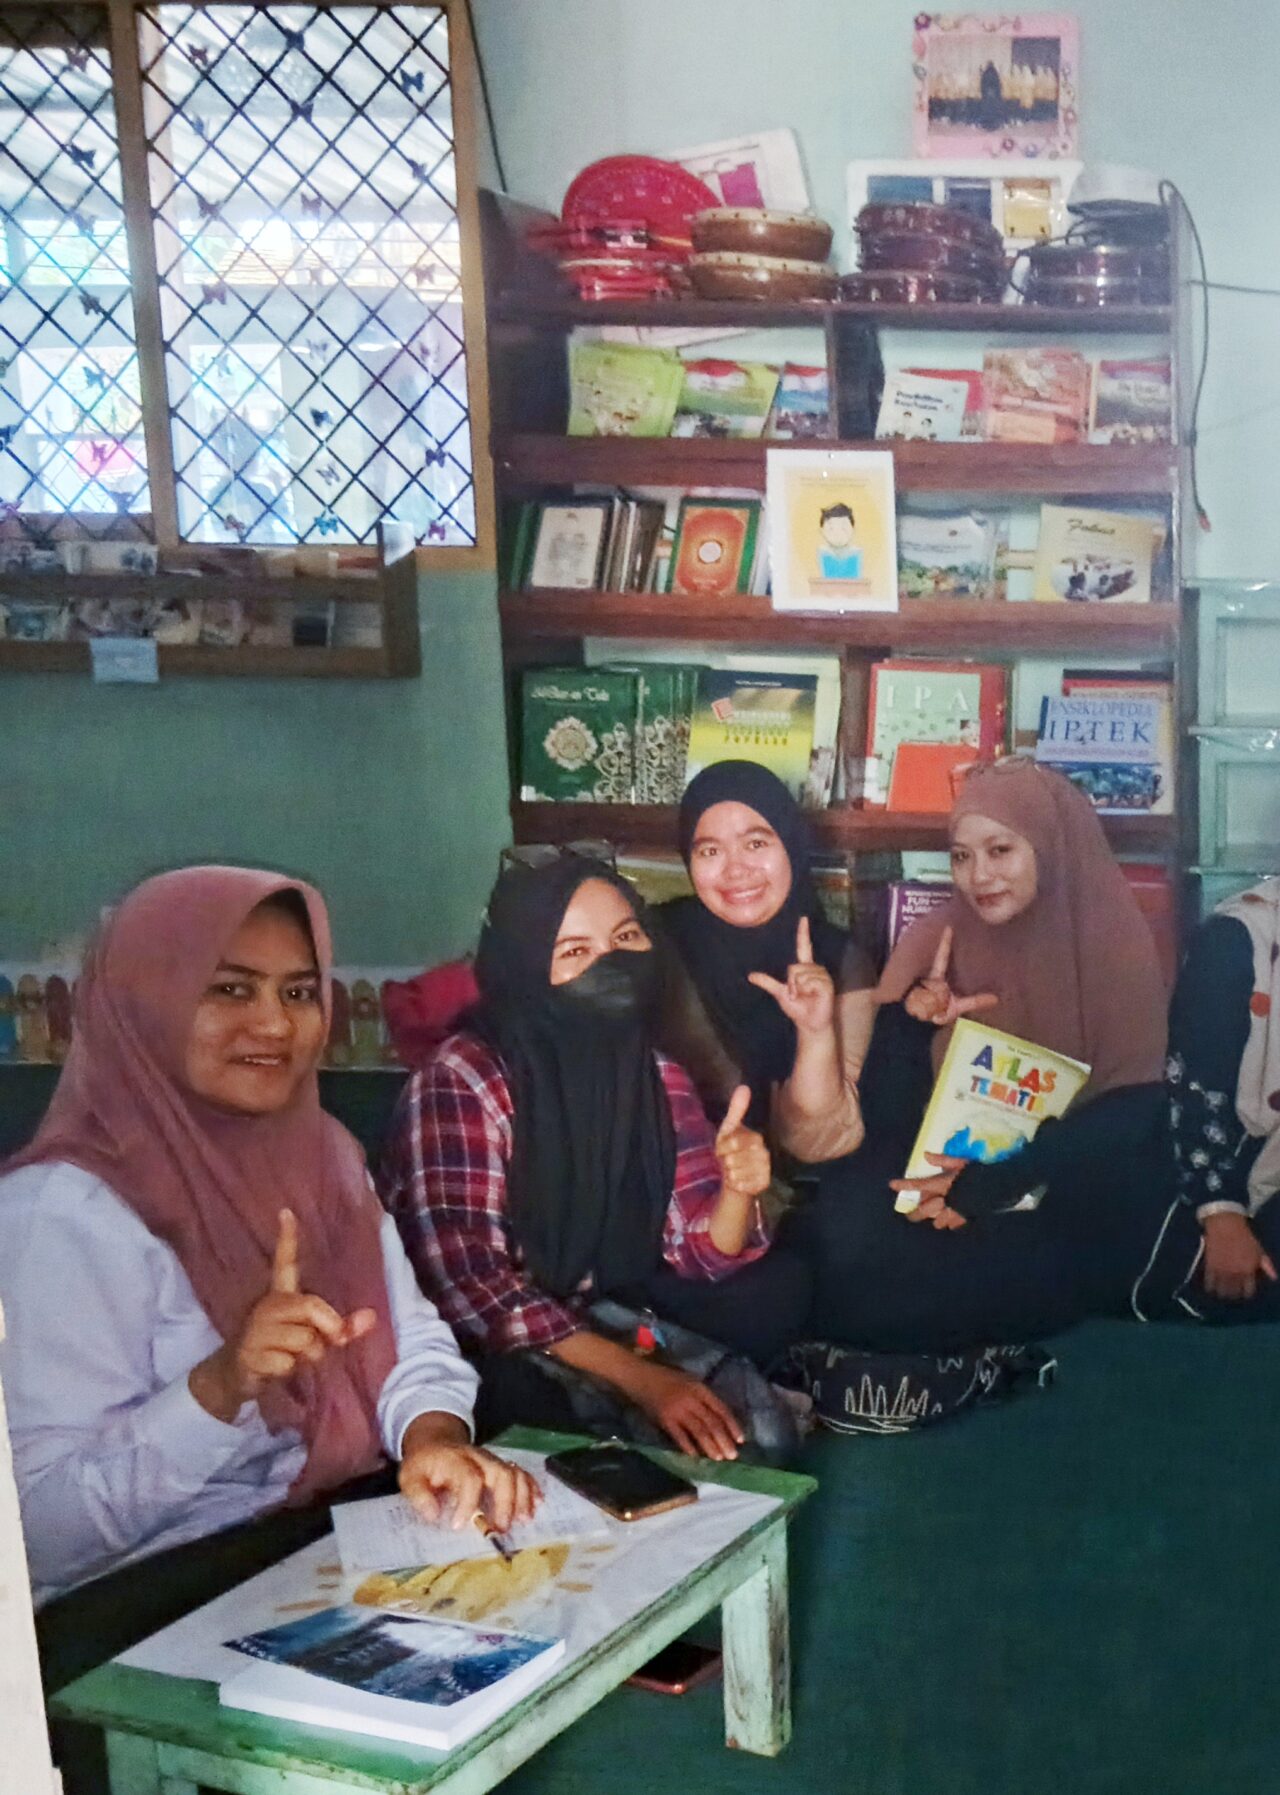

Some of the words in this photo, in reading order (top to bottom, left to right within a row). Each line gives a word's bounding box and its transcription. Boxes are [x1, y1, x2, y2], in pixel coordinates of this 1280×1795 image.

[1050, 720, 1152, 743] IPTEK
[970, 1044, 1057, 1094] ATLAS
[970, 1075, 1045, 1113] TEMATIK
